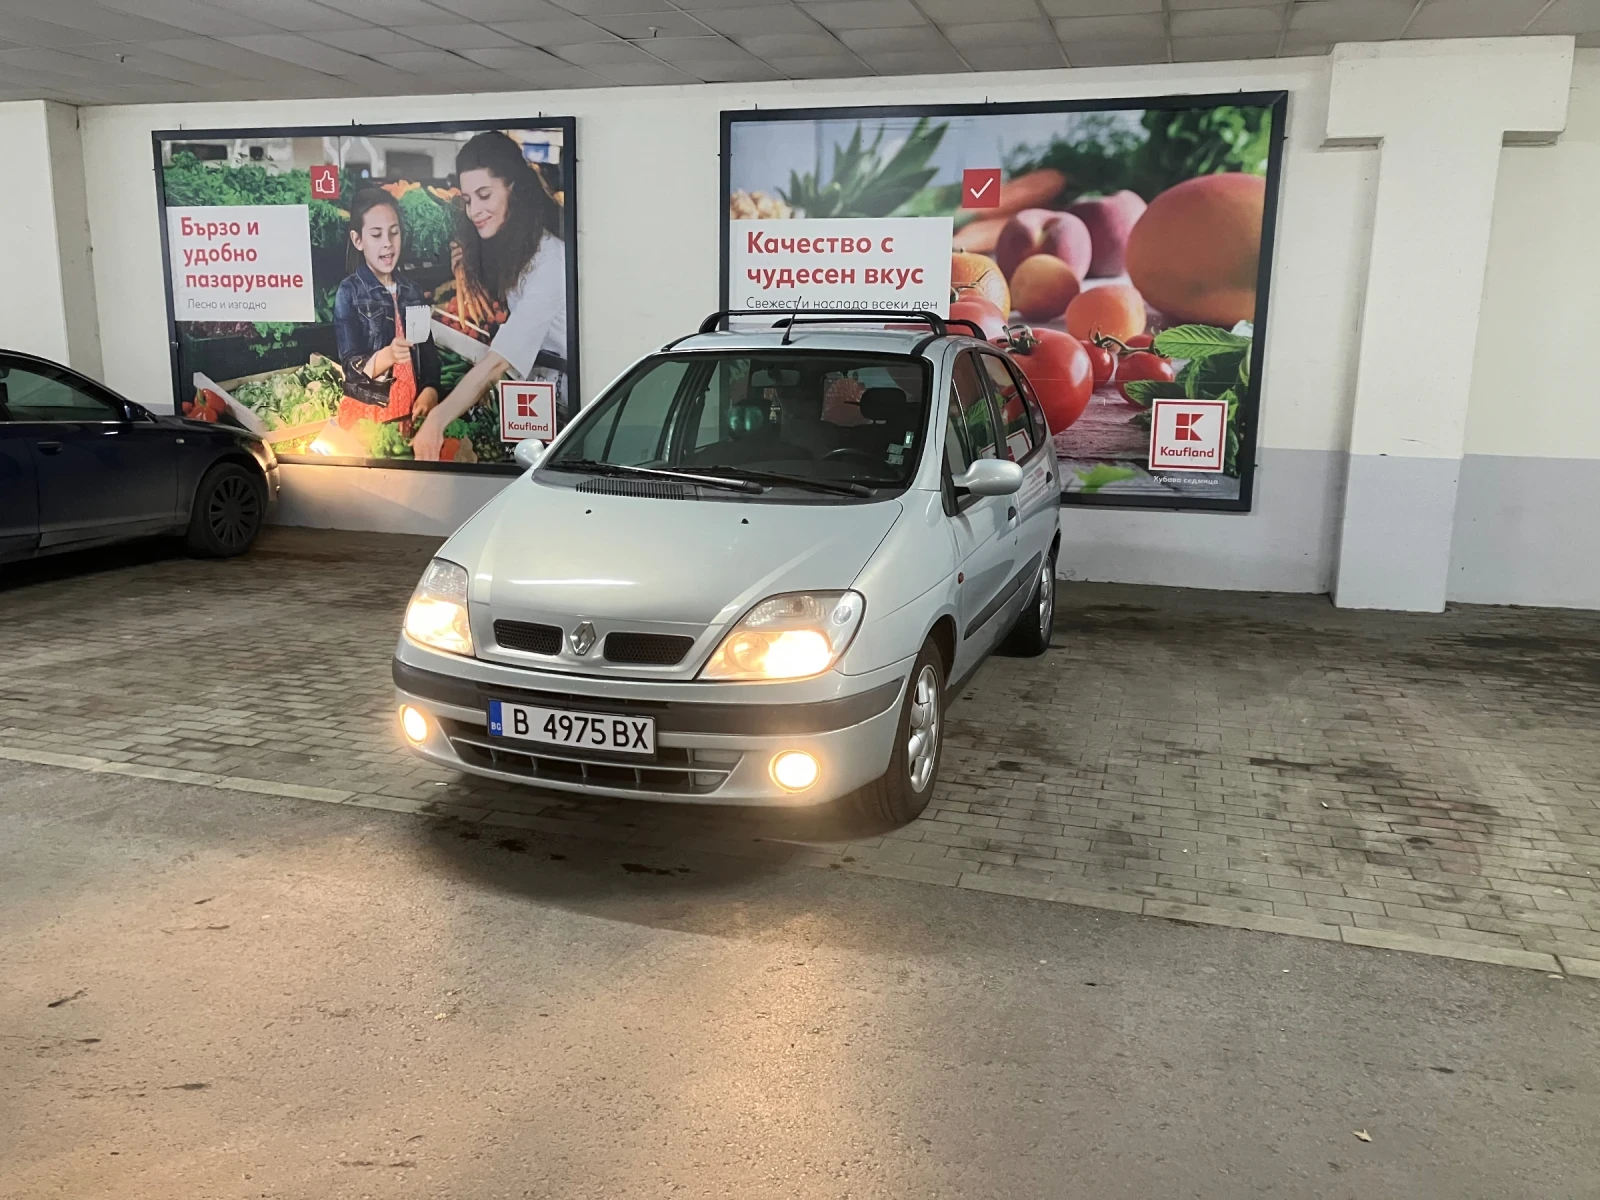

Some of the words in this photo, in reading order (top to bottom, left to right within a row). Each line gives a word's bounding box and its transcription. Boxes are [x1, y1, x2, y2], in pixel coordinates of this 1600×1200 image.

[181, 216, 241, 241] Бързо
[247, 221, 259, 236] и
[747, 231, 872, 254] Качество
[880, 237, 894, 253] с
[183, 242, 257, 267] удобно
[185, 274, 304, 293] пазаруване
[747, 268, 855, 289] чудесен
[864, 268, 924, 290] вкус
[187, 298, 218, 309] Лесно
[219, 301, 226, 309] и
[228, 301, 267, 310] изгодно
[746, 296, 797, 309] Свежест
[801, 300, 810, 309] и
[813, 300, 868, 310] наслада
[872, 300, 909, 309] всеки
[912, 301, 938, 311] ден
[508, 421, 548, 431] Kaufland
[1160, 446, 1215, 458] Kaufland
[1153, 475, 1182, 484] Хубава
[1183, 477, 1219, 486] седмица
[491, 721, 502, 731] BG
[513, 708, 529, 735] B
